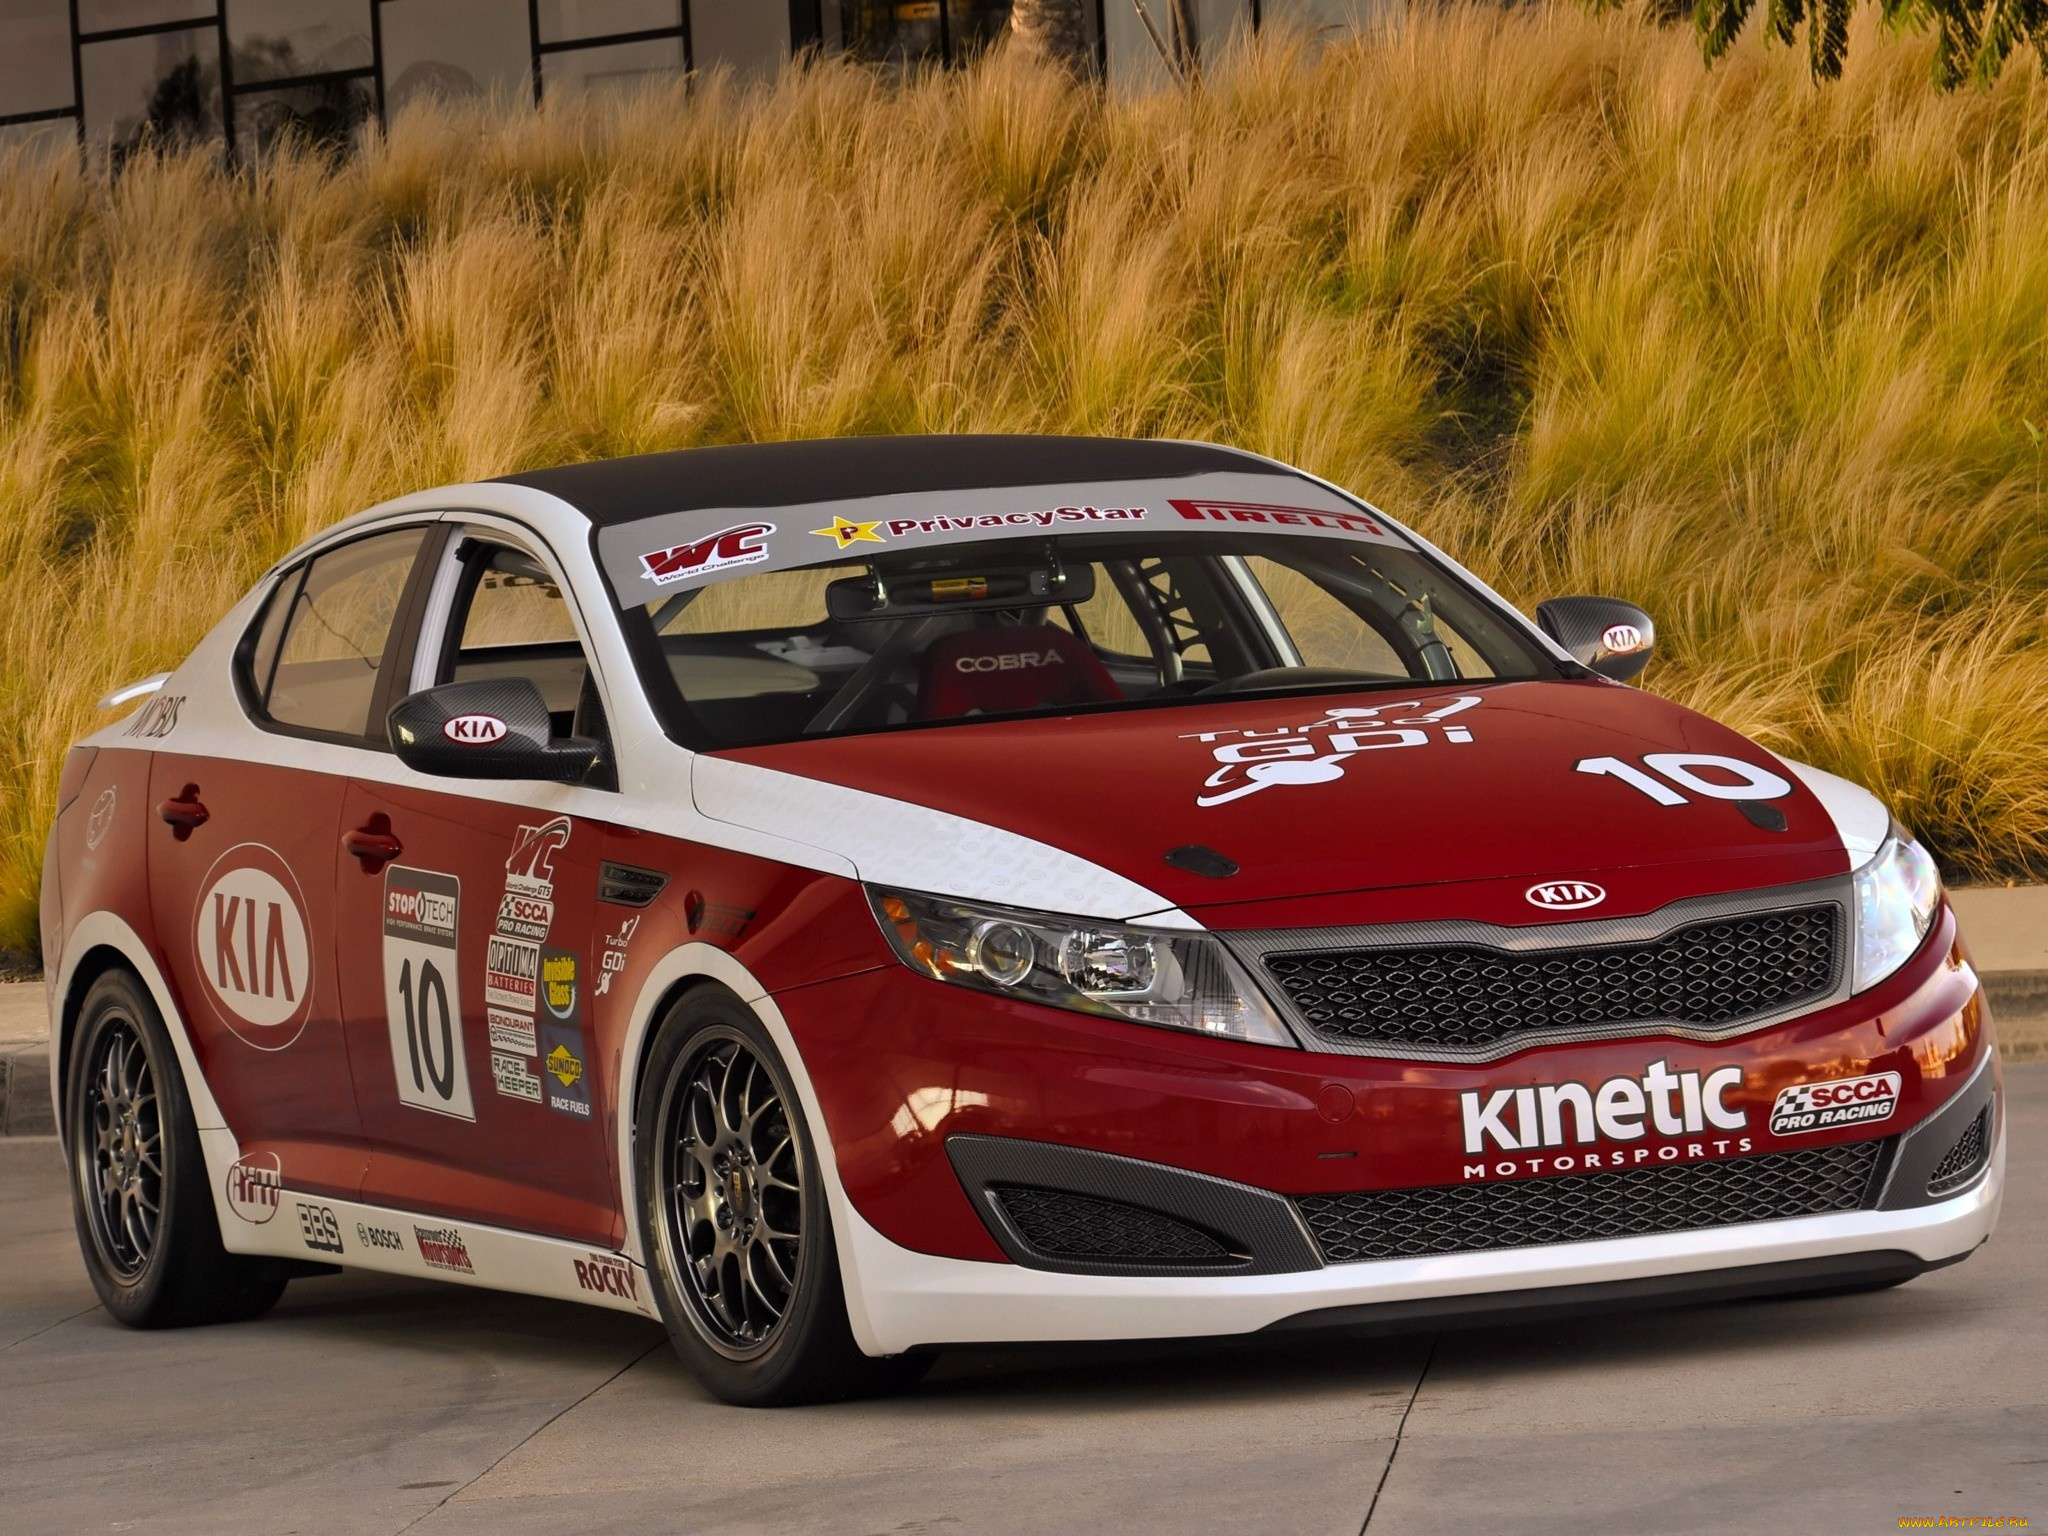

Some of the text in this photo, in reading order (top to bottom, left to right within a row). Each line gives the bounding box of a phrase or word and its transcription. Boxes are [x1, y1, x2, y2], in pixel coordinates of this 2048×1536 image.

[887, 506, 1148, 537] PrivacyStar
[1167, 499, 1385, 537] PIRELLI
[658, 553, 766, 584] World Challenge
[1607, 628, 1638, 649] KIA
[955, 648, 1066, 674] COBRA
[453, 720, 498, 738] KIA
[1574, 753, 1794, 807] 10
[1537, 884, 1597, 904] KIA
[514, 900, 549, 923] SCCA
[498, 919, 547, 938] PRO RACING
[605, 934, 628, 948] Turbo
[214, 892, 296, 1003] KIA
[489, 941, 538, 979] OPTIMA
[543, 956, 576, 982] Invisible
[488, 972, 534, 995] BATTERIES
[549, 981, 571, 1007] Glass
[398, 957, 455, 1101] 10
[489, 1013, 534, 1033] BONDURANT
[493, 1057, 526, 1076] RACE-
[548, 1056, 580, 1078] SUNOCO
[497, 1074, 540, 1097] KEEPER
[1811, 1078, 1896, 1107] SCCA
[550, 1095, 590, 1116] RACE FUELS
[1774, 1101, 1891, 1132] PRO RACING
[1463, 1137, 1753, 1180] MOTORSPORTS
[296, 1202, 344, 1254] BBS
[367, 1226, 404, 1251] BOSCH
[573, 1258, 639, 1302] ROCKY
